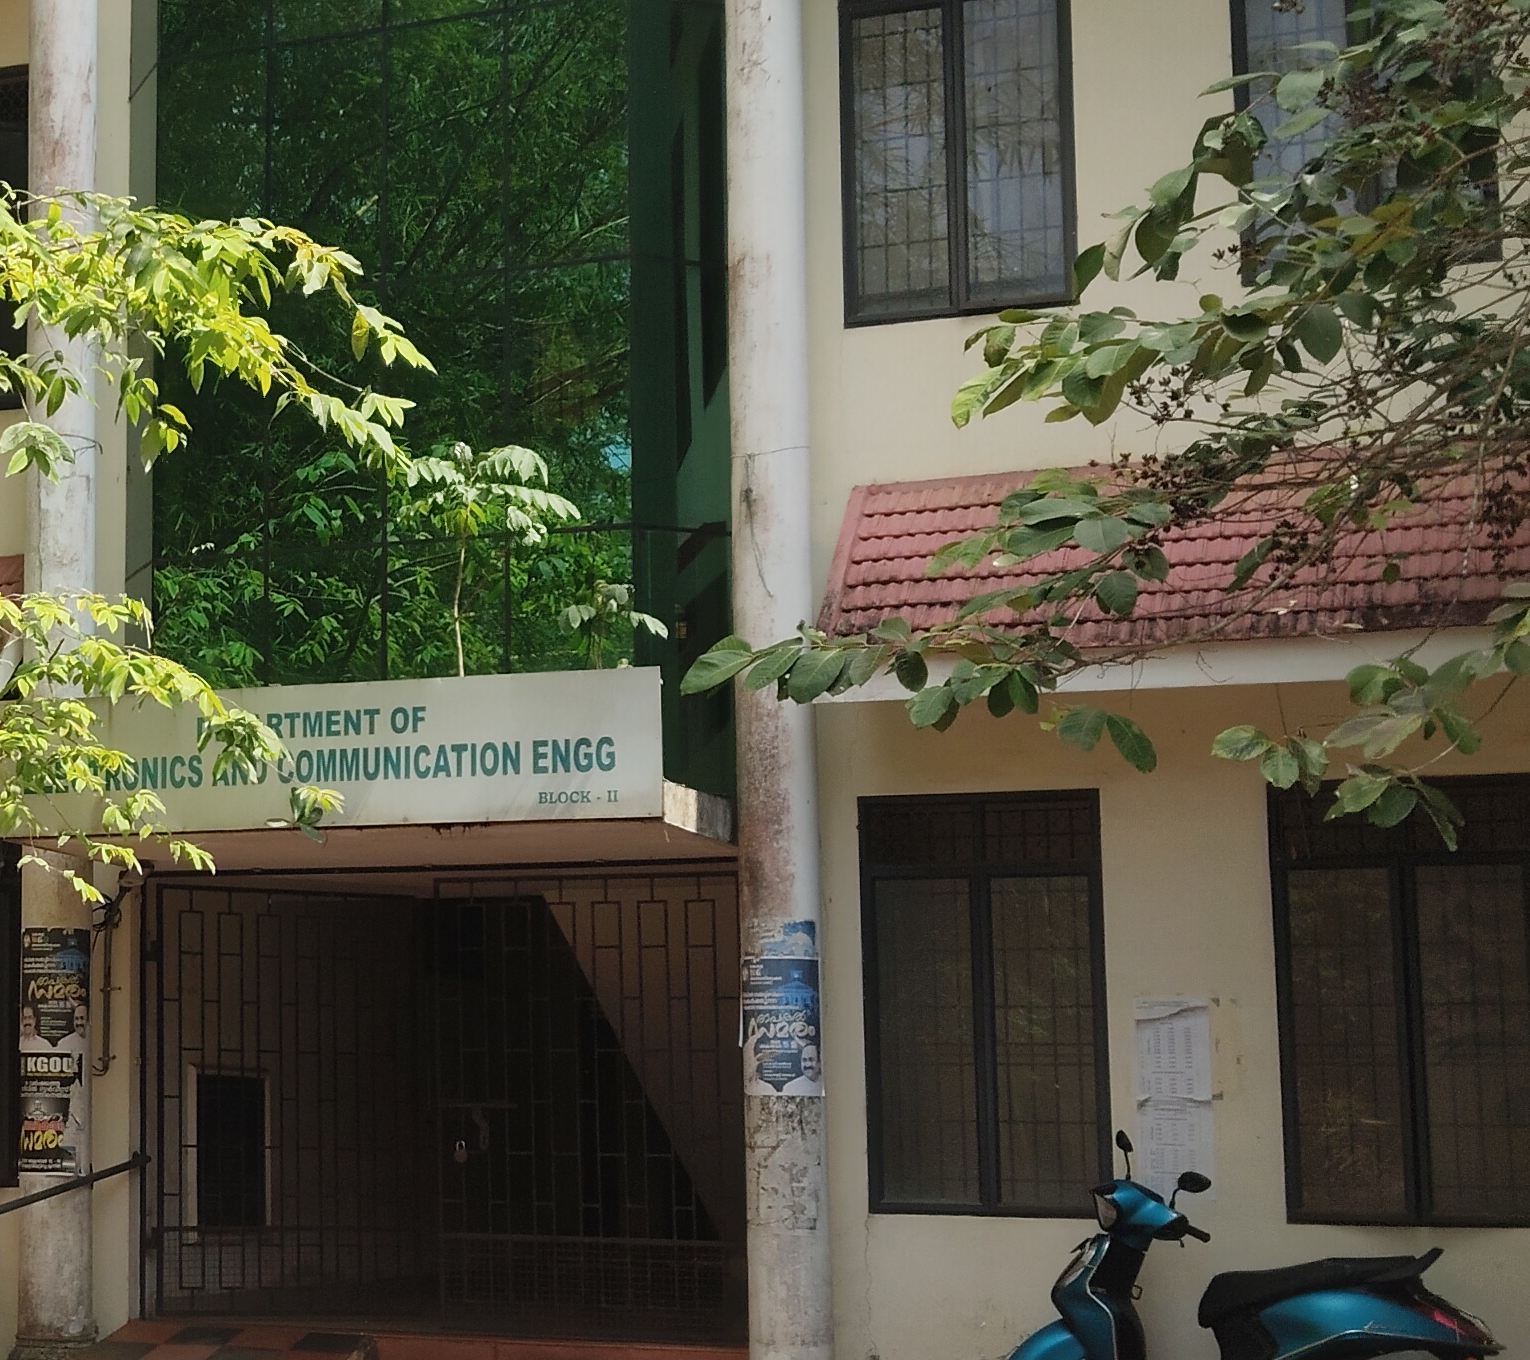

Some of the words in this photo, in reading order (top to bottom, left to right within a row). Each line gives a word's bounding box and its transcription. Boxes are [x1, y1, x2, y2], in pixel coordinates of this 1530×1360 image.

[197, 707, 380, 744] RTMENT
[390, 705, 427, 735] OF
[23, 754, 204, 795] RONICS
[277, 740, 522, 784] COMMUNICATION
[532, 737, 617, 775] ENGG
[537, 790, 592, 805] BLOCK
